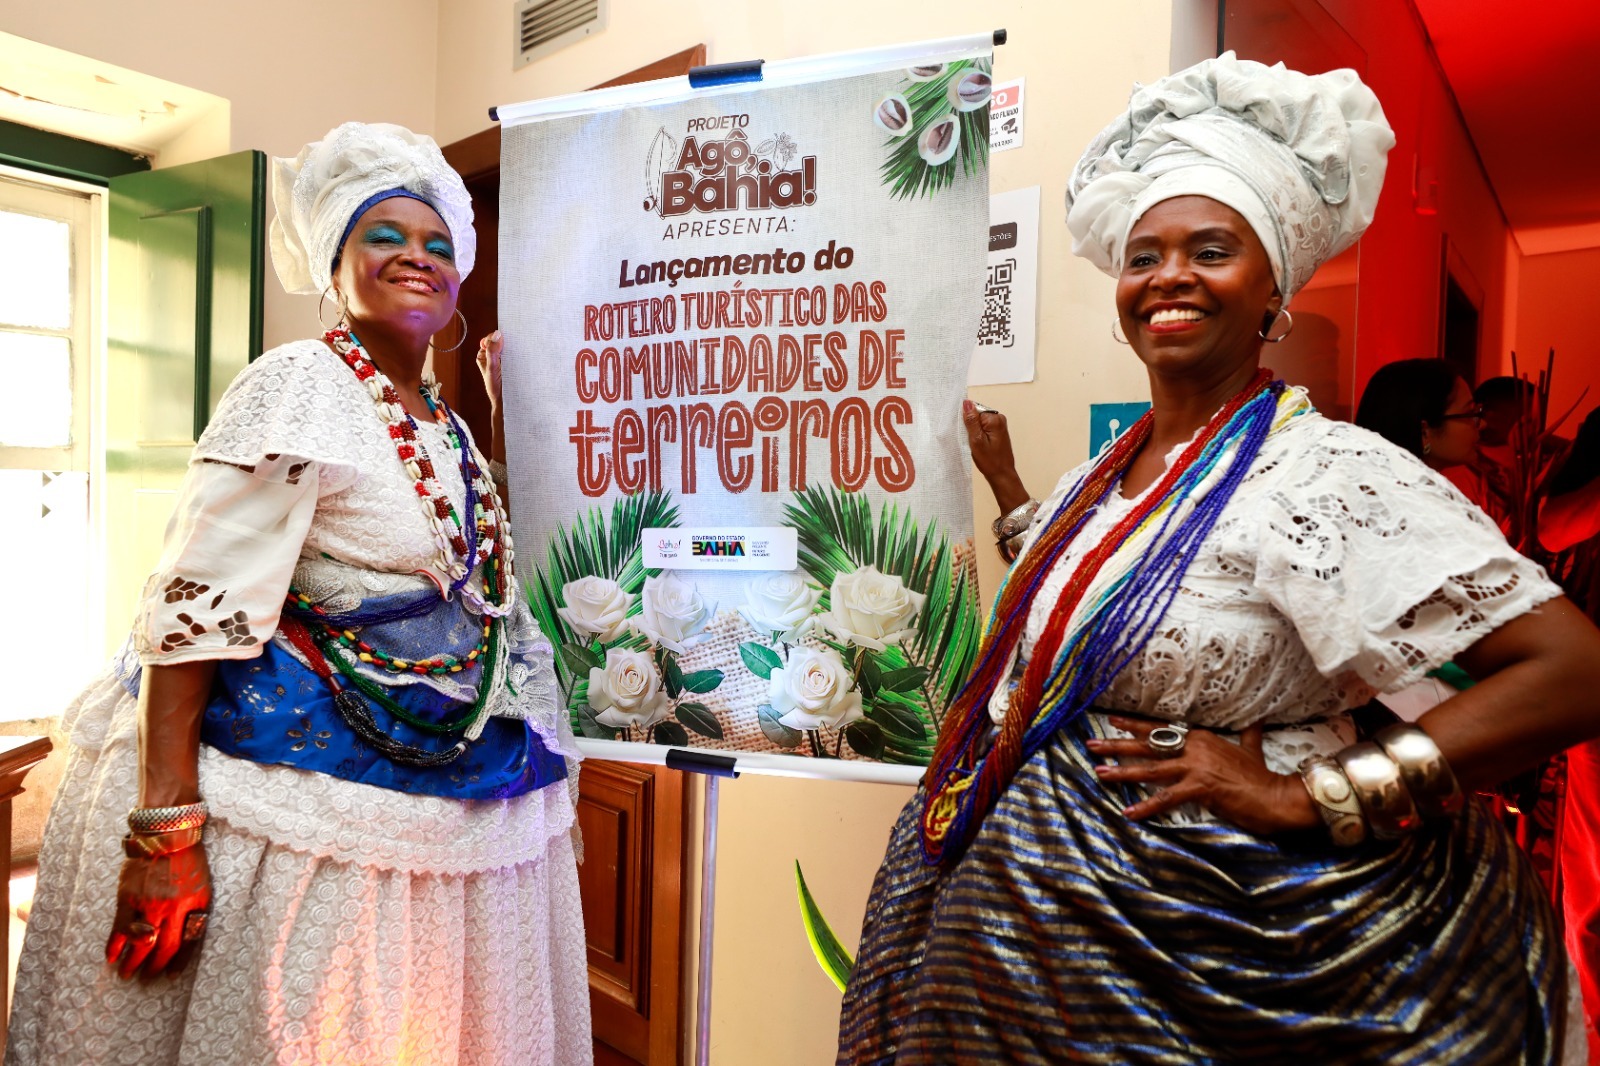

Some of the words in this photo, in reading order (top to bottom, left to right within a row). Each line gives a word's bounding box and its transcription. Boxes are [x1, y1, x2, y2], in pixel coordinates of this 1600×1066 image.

[687, 113, 750, 133] PROJETO
[675, 128, 758, 177] Agô,
[661, 154, 817, 218] Bahia!
[662, 216, 797, 241] APRESENTA:
[618, 247, 806, 288] Lançamento
[813, 240, 855, 271] do
[584, 294, 677, 341] ROTEIRO
[680, 279, 827, 331] TURÍSTICO
[832, 280, 888, 325] DAS
[575, 331, 849, 404] COMUNIDADES
[857, 329, 907, 391] DE
[568, 395, 916, 497] terreiros
[692, 541, 746, 556] BAHIA
